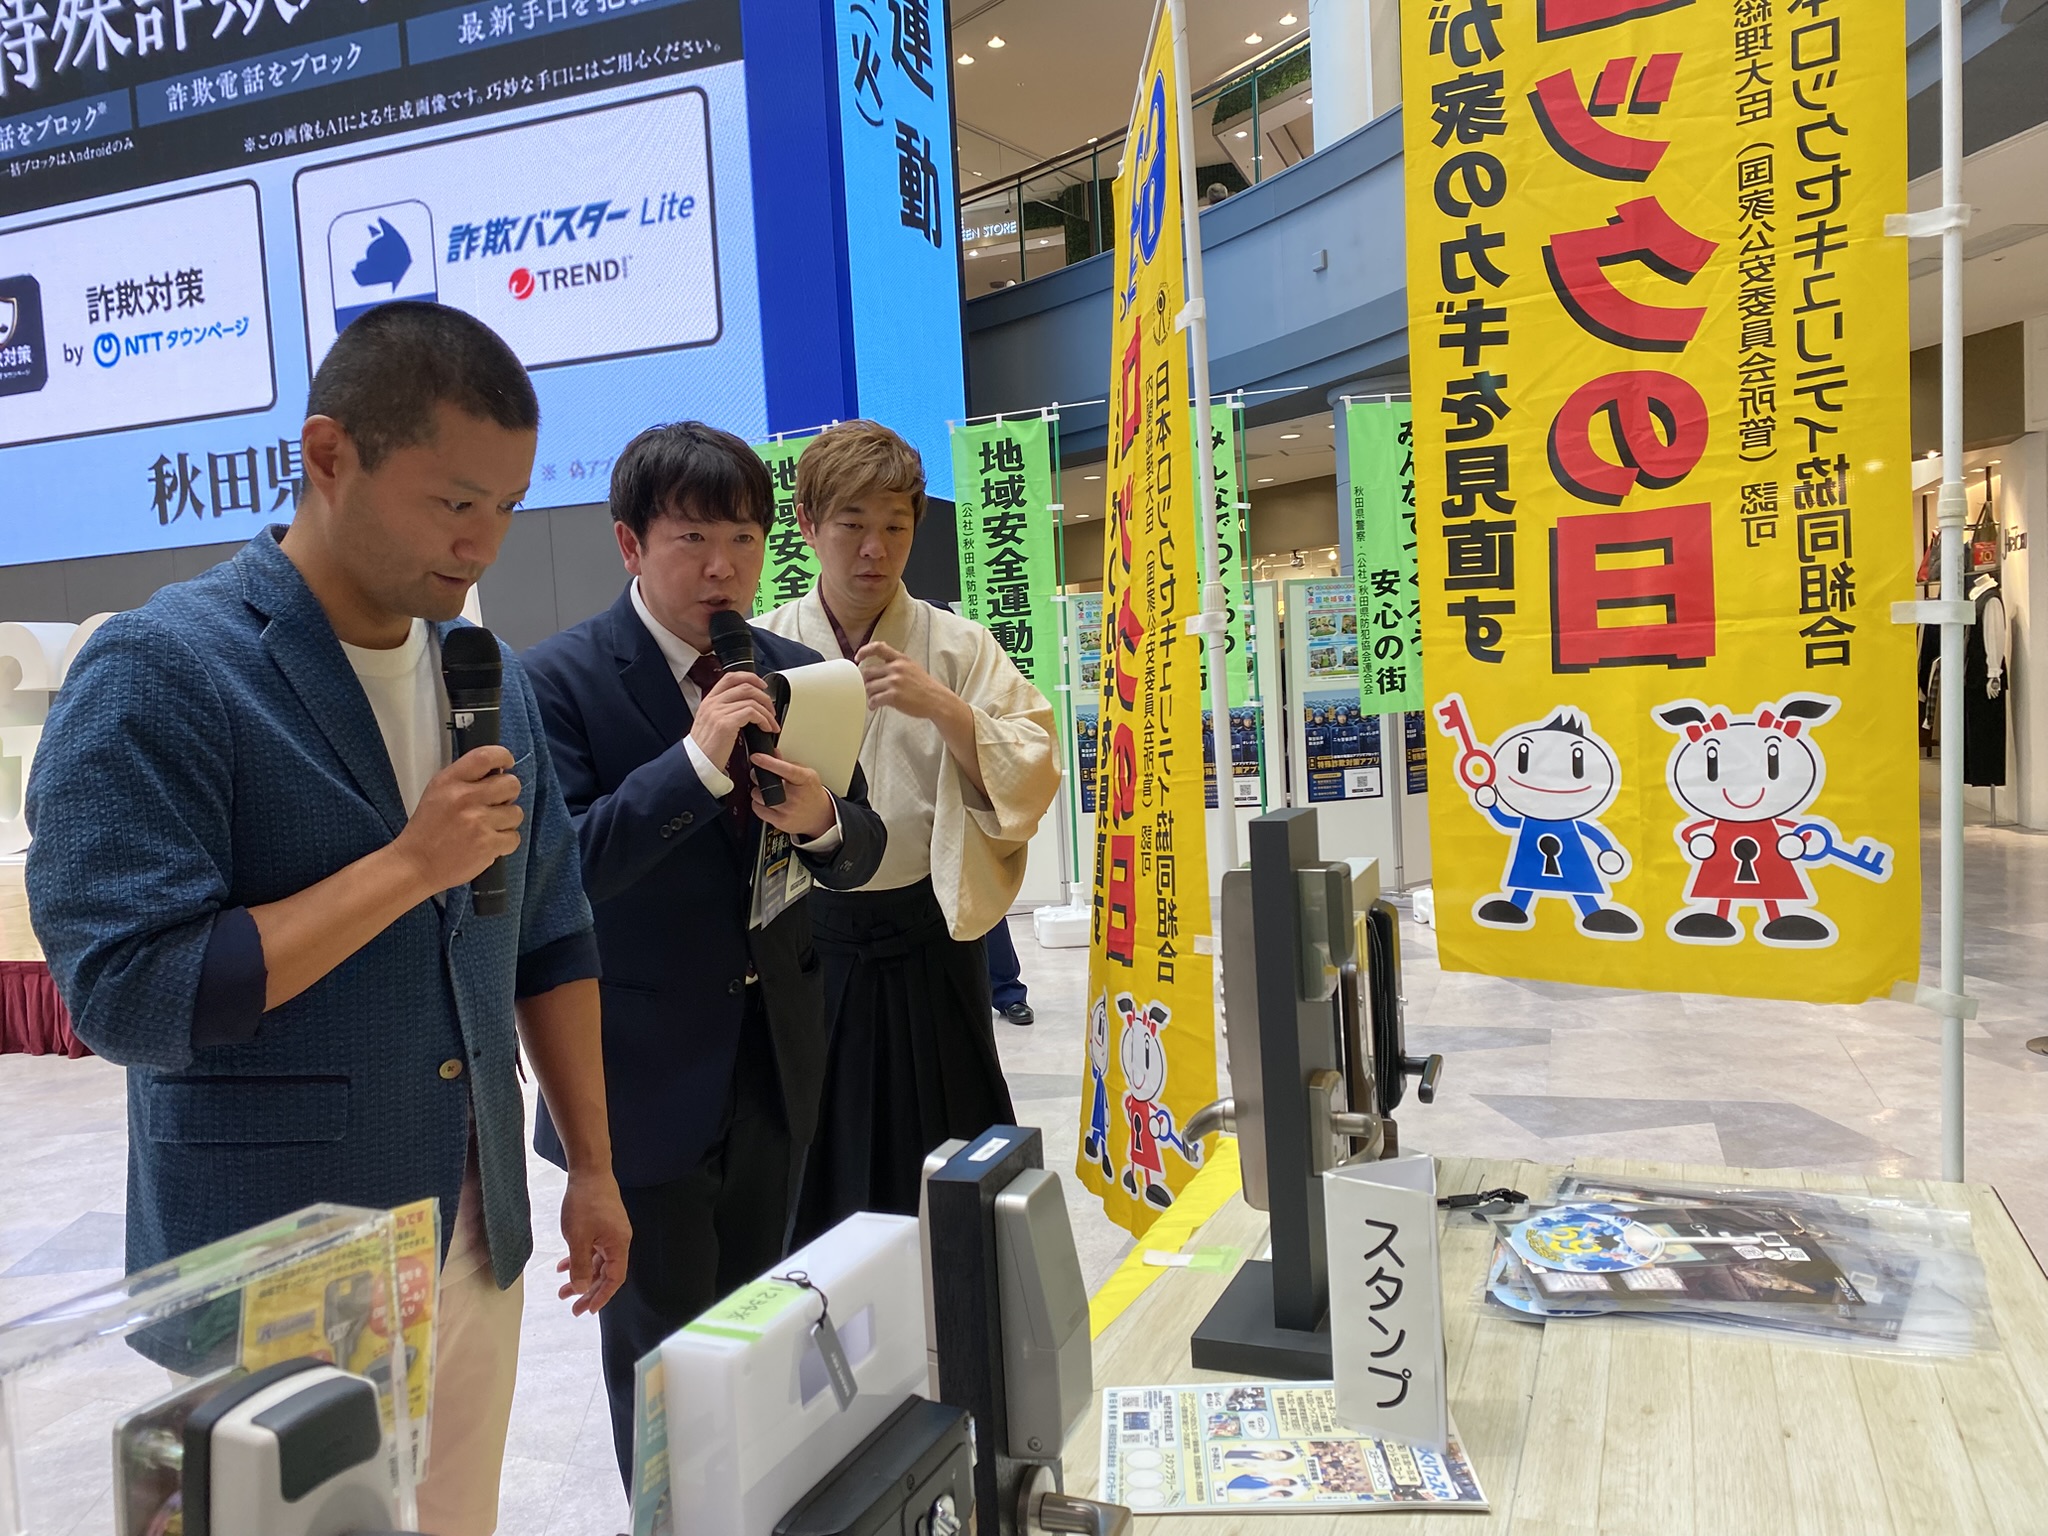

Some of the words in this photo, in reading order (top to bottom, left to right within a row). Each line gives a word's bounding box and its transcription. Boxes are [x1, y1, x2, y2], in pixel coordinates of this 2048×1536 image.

[458, 0, 650, 46] 最新手口を
[165, 42, 362, 112] 詐欺電話をブロック
[849, 0, 885, 127] (火)
[446, 199, 631, 264] 詐欺バスター
[640, 191, 695, 226] Lite
[983, 220, 1017, 238] STORE
[86, 266, 206, 325] 詐欺対策
[537, 258, 620, 292] TREND
[0, 344, 32, 367] 対策
[63, 343, 84, 366] by
[765, 456, 815, 609] 地域安全
[1370, 568, 1407, 696] 安心の街
[1363, 1218, 1413, 1409] スタンプ
